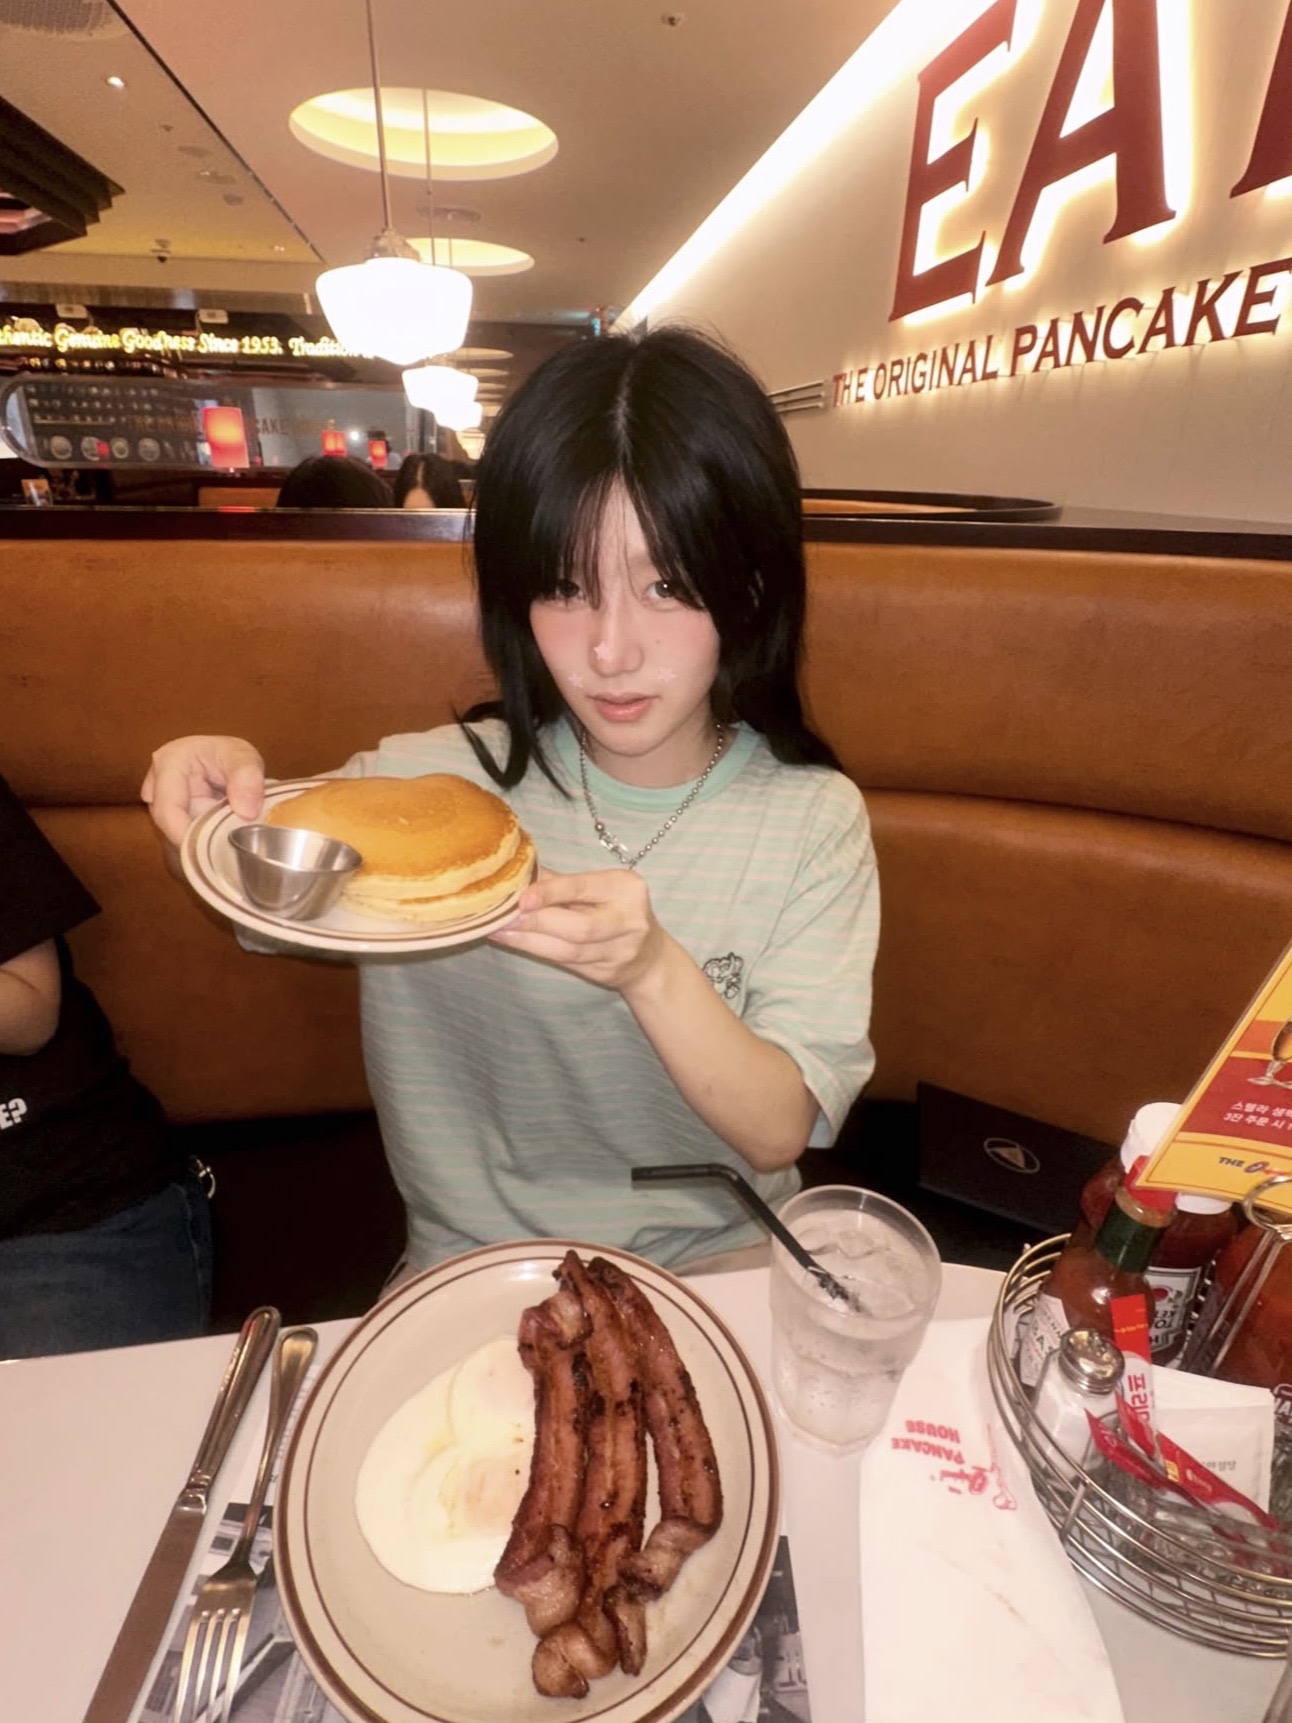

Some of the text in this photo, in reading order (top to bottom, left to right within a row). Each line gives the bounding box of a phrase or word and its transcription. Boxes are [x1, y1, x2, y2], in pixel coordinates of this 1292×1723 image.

[888, 0, 1292, 321] EA
[120, 328, 196, 353] Goodness
[197, 332, 239, 354] Since
[240, 335, 284, 355] 1953.
[832, 257, 1292, 407] THE ORIGINAL PANCAKE
[1230, 1101, 1269, 1114] 스텔라
[1245, 1114, 1269, 1127] 주문
[1270, 1119, 1286, 1130] 시
[1218, 1156, 1245, 1168] THE
[905, 1419, 961, 1444] HOUSE
[891, 1437, 966, 1466] PANCAKE
